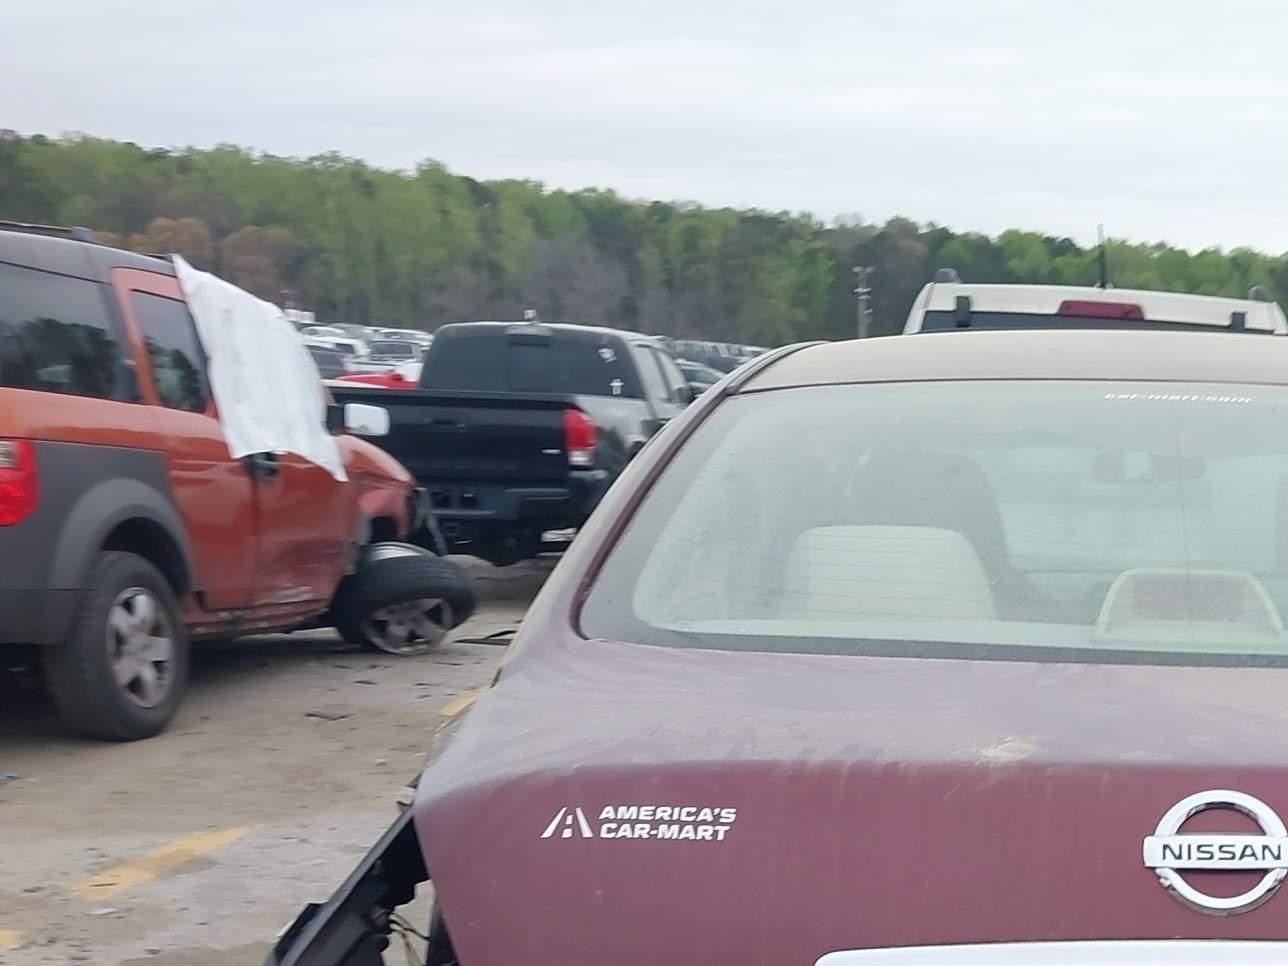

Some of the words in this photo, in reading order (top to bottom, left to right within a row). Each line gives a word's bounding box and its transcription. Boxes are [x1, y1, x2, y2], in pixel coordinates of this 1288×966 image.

[598, 805, 737, 824] AMERICA'S
[599, 822, 731, 841] CAR-MART
[1161, 843, 1282, 861] NISSAN
